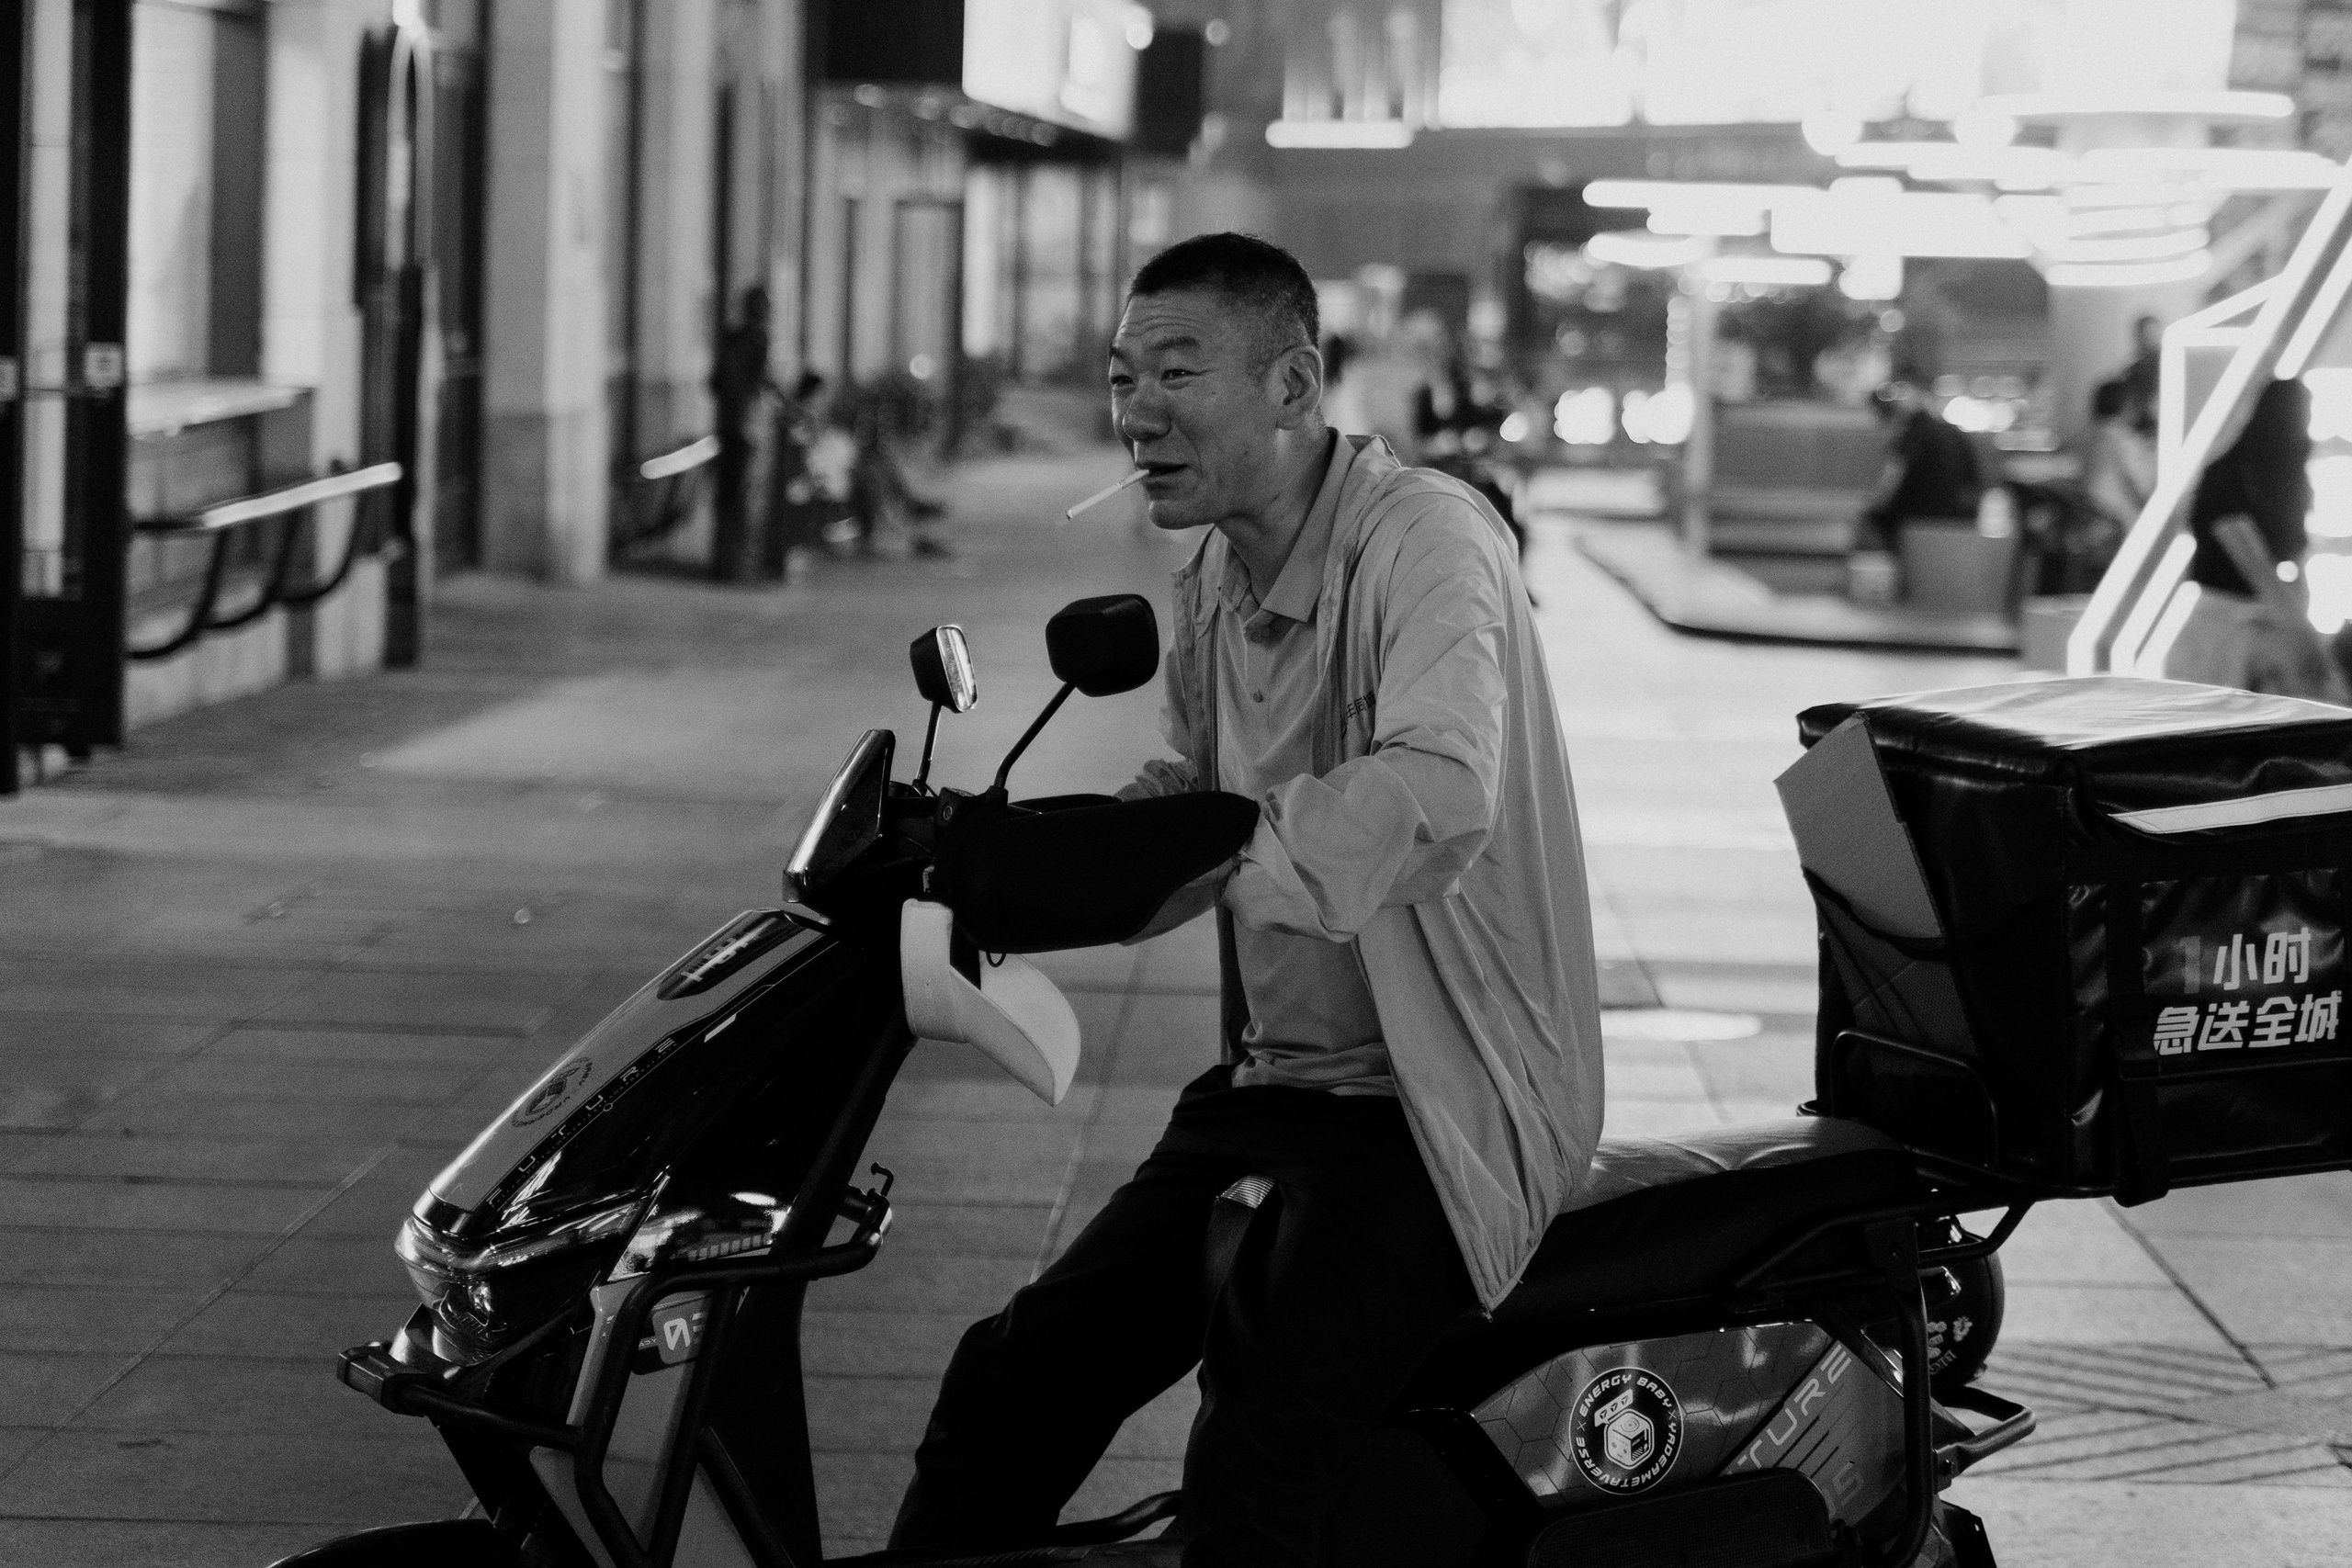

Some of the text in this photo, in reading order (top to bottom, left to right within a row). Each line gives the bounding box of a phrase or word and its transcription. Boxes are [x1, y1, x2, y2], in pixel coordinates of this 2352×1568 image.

[2178, 927, 2312, 994] 1小时
[2153, 990, 2343, 1055] 急送全城
[485, 1037, 675, 1205] FUTURE
[1579, 1374, 1672, 1417] ENERGY BABY
[1728, 1344, 1852, 1475] TURE
[1576, 1422, 1677, 1488] YADEAMETAVERSE
